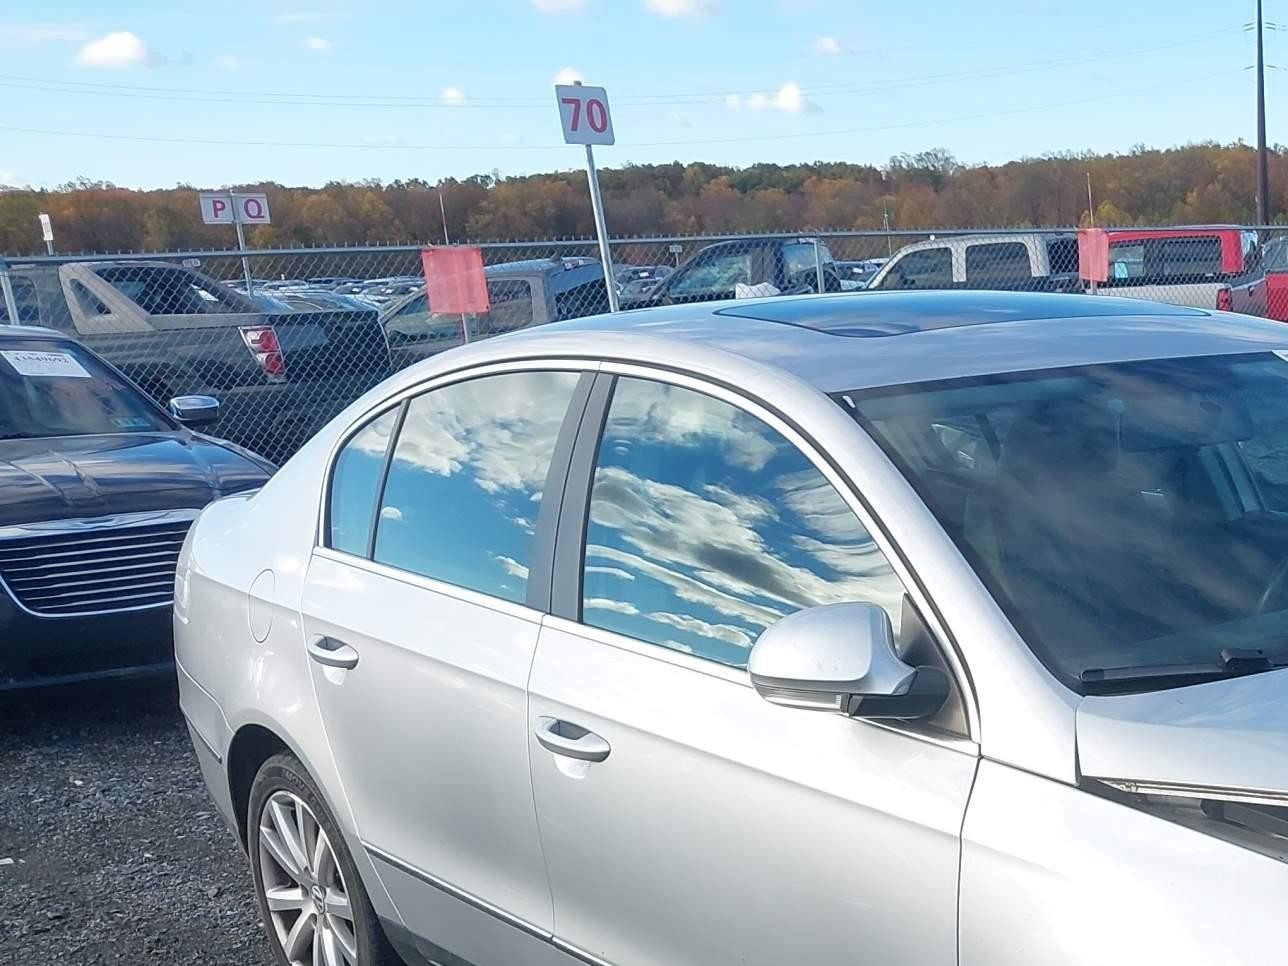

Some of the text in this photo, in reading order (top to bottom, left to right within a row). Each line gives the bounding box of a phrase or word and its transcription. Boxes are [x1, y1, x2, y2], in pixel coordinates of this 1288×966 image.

[561, 98, 608, 133] 70
[212, 199, 226, 218] P
[244, 199, 265, 219] Q
